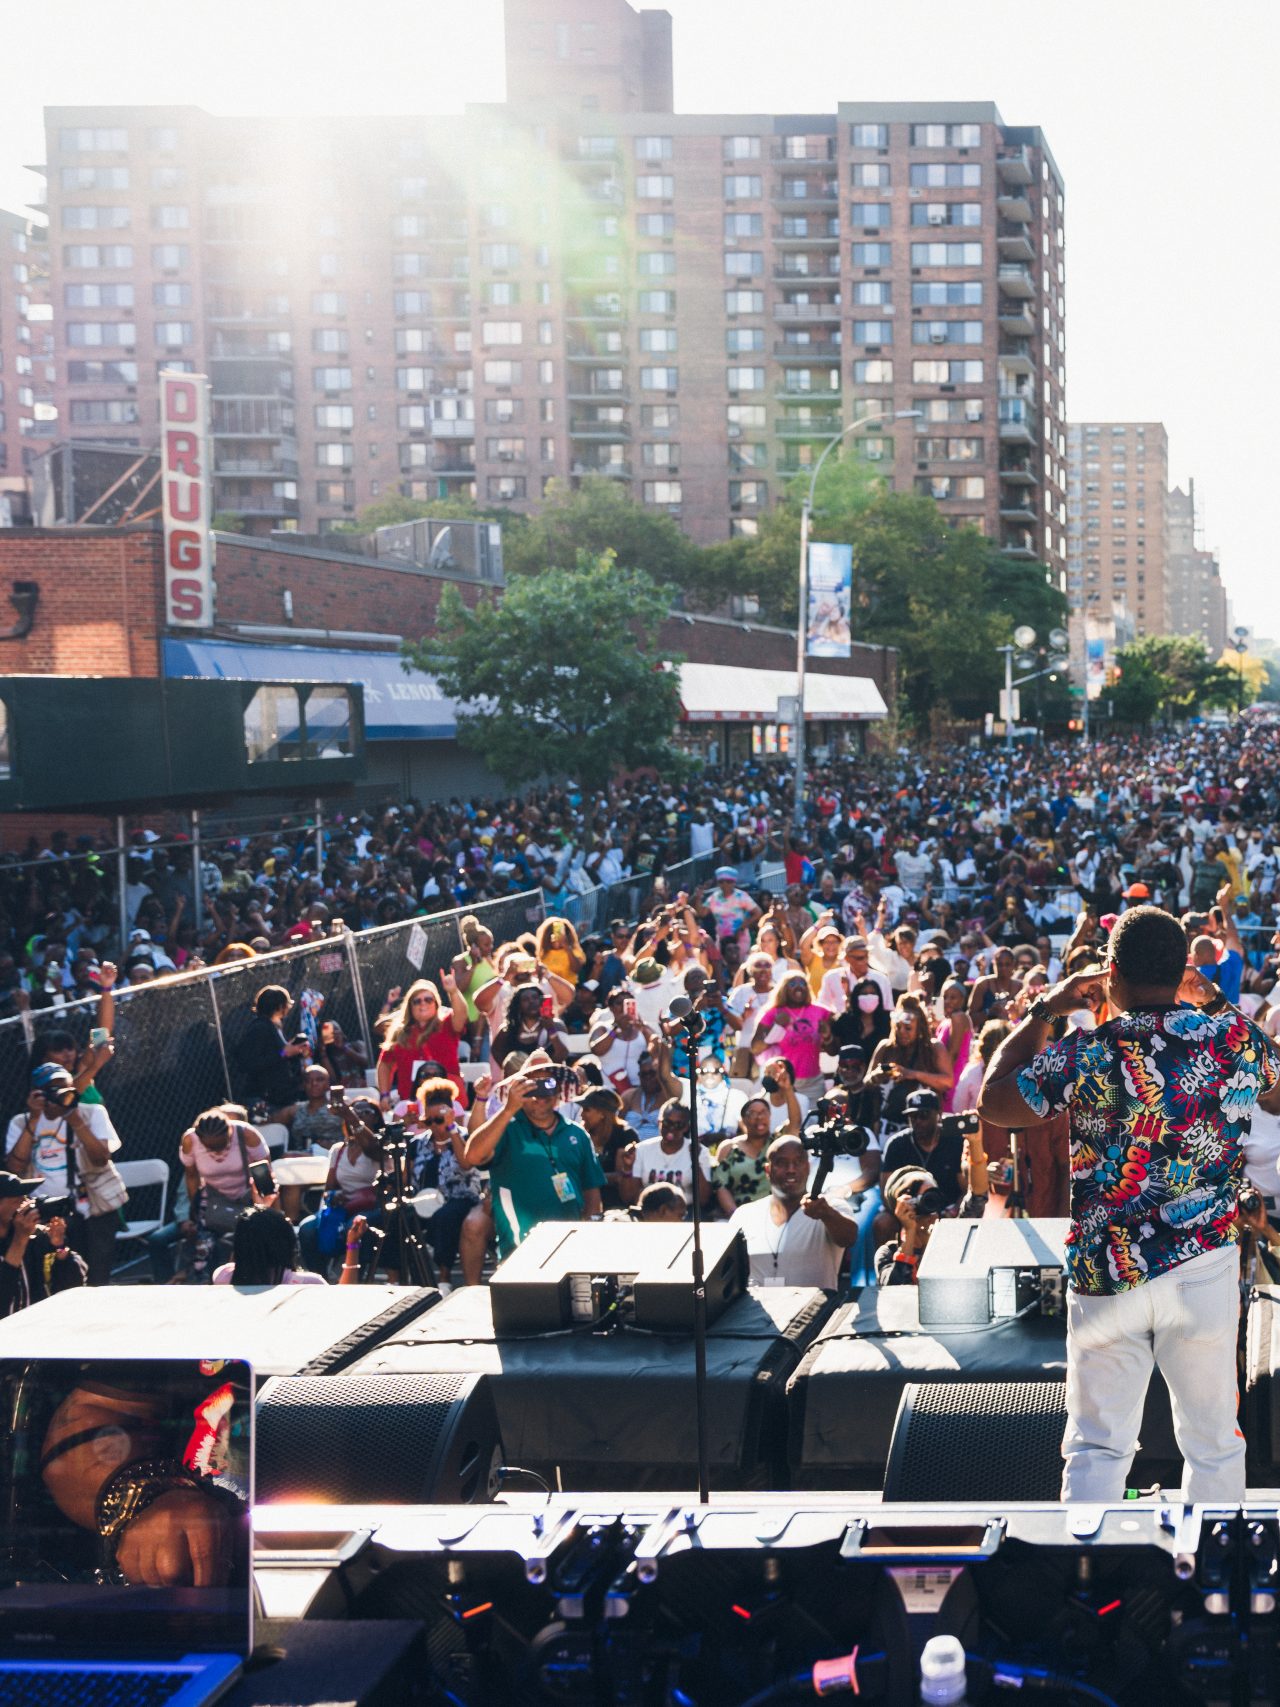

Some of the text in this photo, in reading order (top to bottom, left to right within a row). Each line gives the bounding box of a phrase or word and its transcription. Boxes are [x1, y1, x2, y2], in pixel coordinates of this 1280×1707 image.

[165, 381, 204, 620] DRUGS
[1032, 1053, 1068, 1076] BANG!
[1180, 1050, 1215, 1095] BANG!
